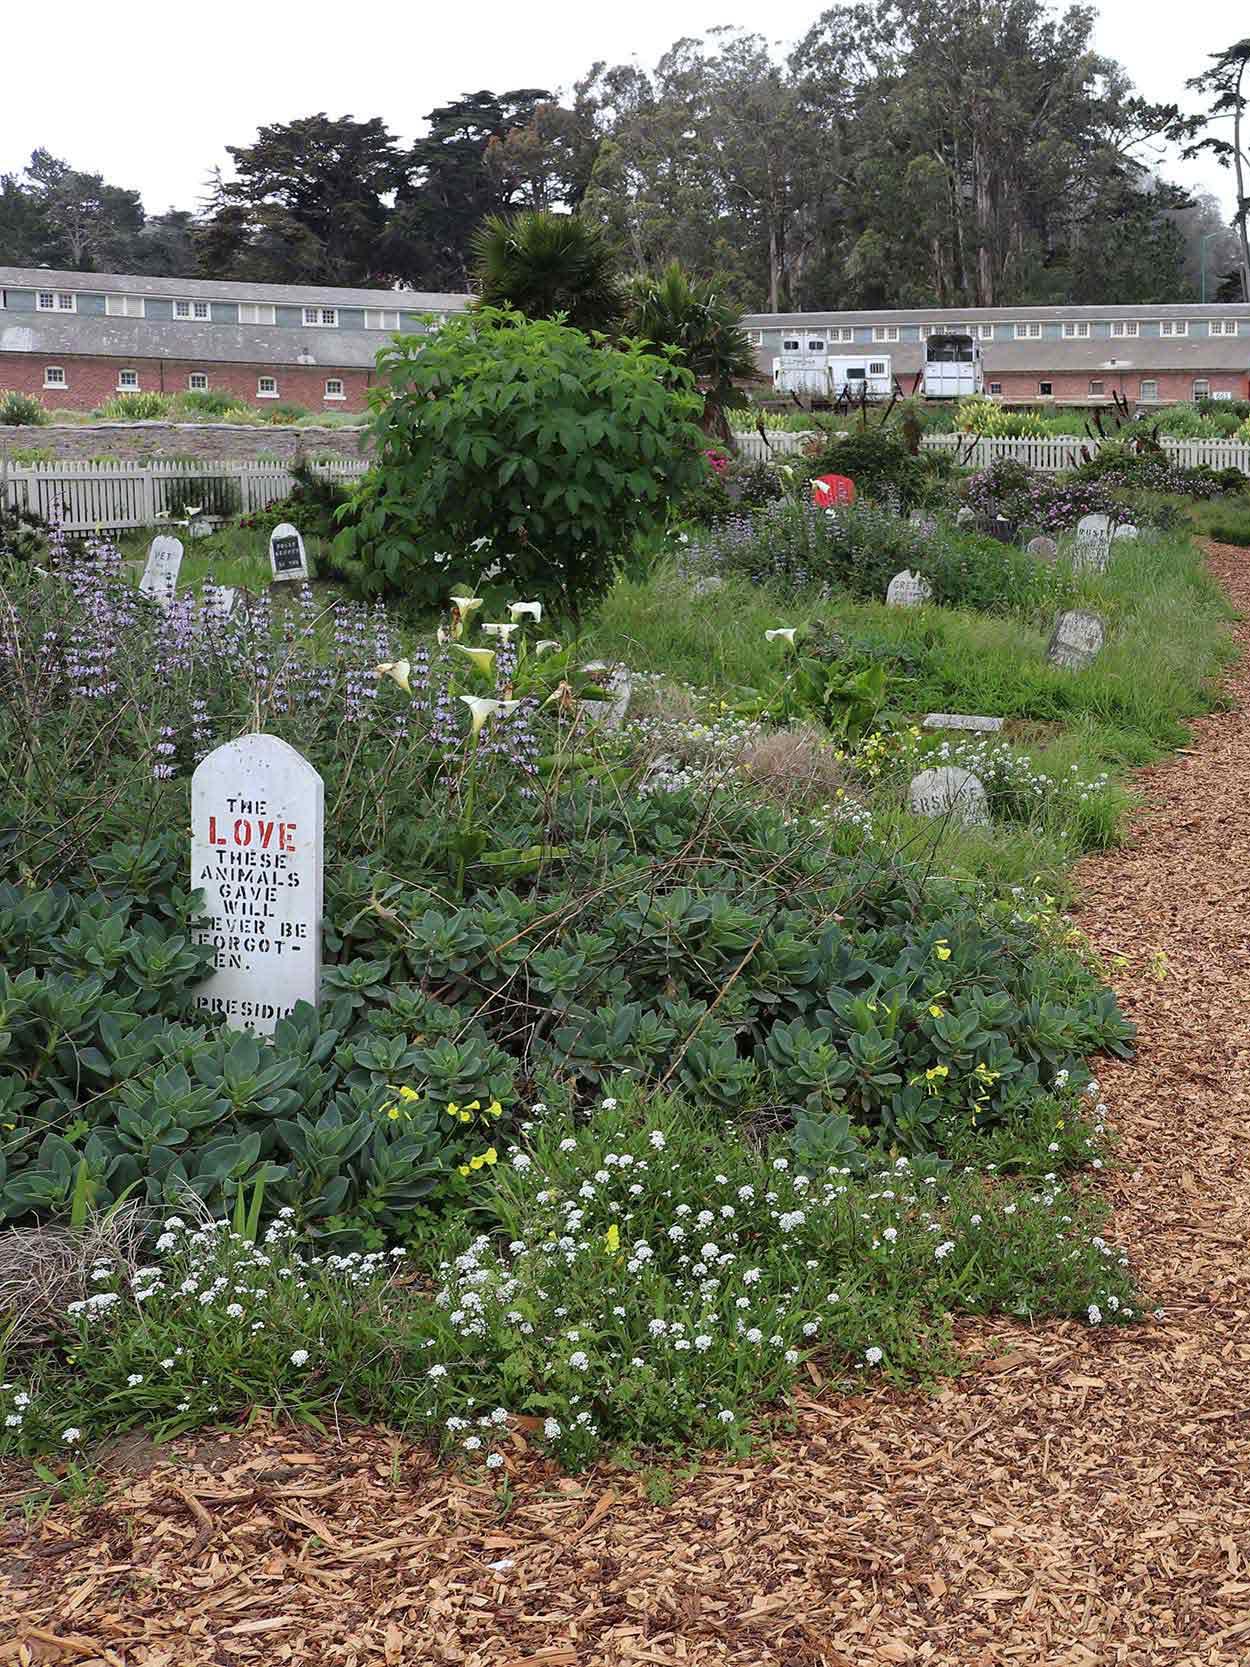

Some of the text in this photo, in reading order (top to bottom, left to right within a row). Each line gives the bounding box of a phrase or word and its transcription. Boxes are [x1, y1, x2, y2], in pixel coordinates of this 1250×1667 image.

[226, 798, 267, 815] THE
[209, 816, 297, 852] LOVE
[216, 850, 288, 869] THESE
[200, 865, 300, 888] ANIMALS
[220, 884, 278, 902] GAVE
[223, 900, 275, 917] WILL
[200, 917, 307, 938] EVER BE
